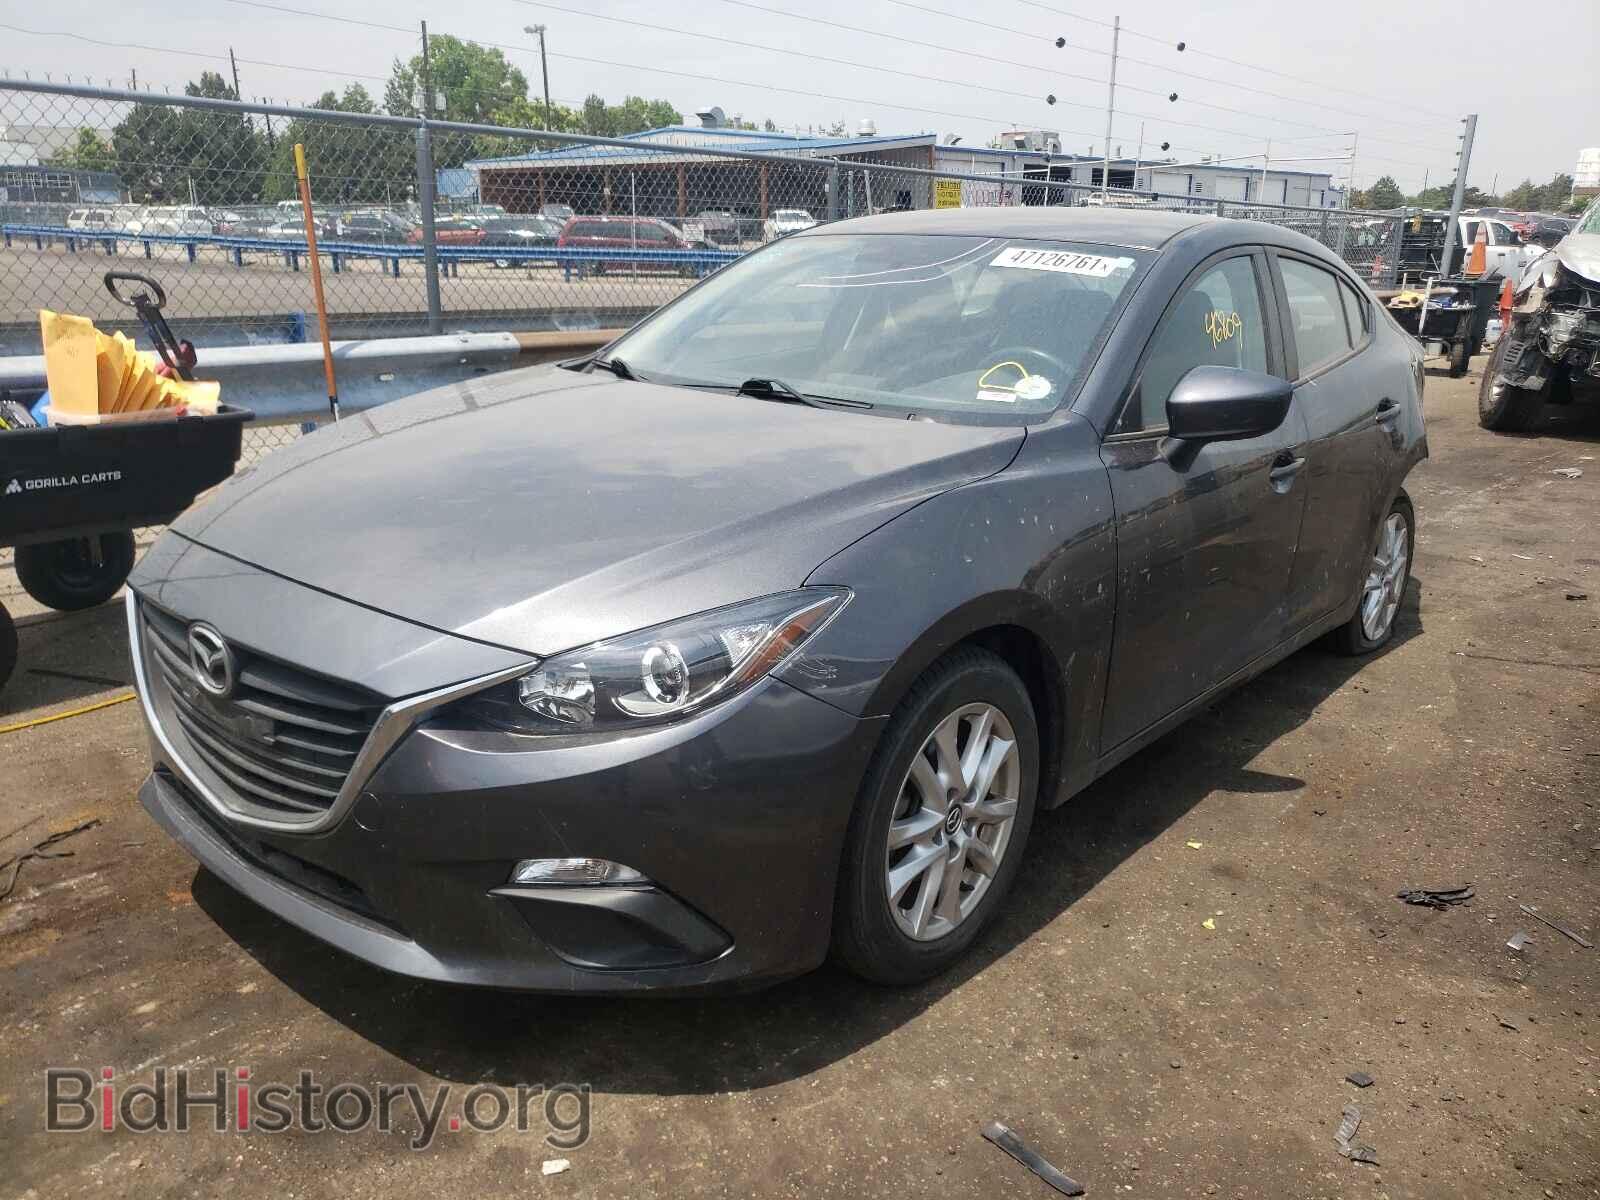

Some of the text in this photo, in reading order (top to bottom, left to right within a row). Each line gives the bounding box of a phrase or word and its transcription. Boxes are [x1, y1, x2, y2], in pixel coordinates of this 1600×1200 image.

[1011, 250, 1102, 270] 47126761
[25, 471, 121, 490] GORILLA CARTS
